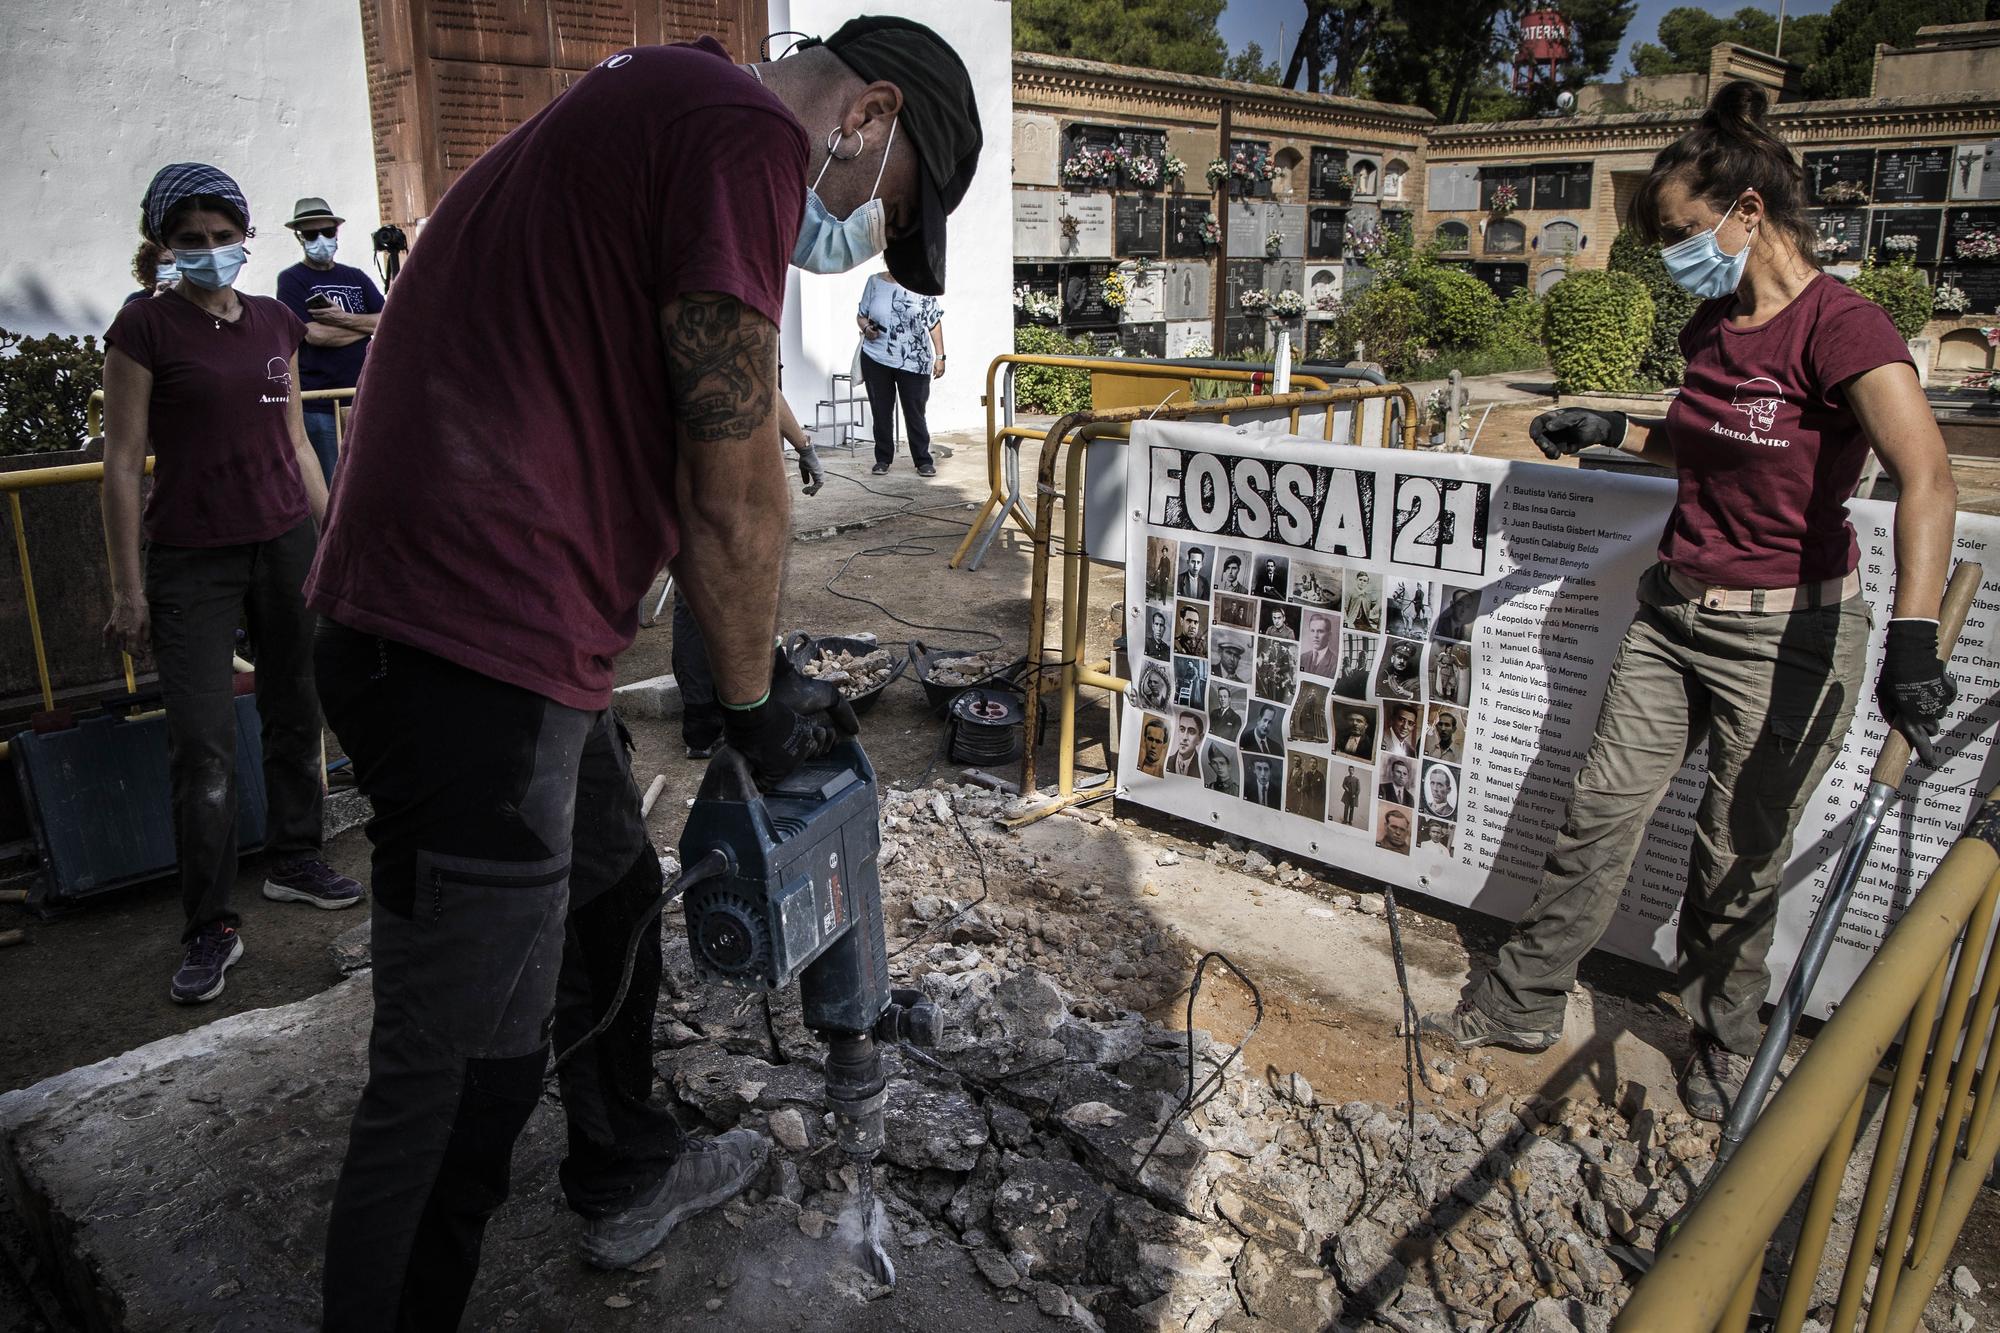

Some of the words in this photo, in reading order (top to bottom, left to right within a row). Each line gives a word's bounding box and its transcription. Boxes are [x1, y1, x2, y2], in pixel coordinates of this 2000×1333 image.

[1505, 485, 1511, 494] 1.
[1514, 486, 1545, 498] Bautista
[1569, 493, 1594, 503] Sirera
[1149, 446, 1373, 559] FOSSA
[1392, 475, 1486, 575] 21
[1513, 503, 1529, 512] Blas
[1532, 506, 1548, 514] Insa
[1511, 519, 1530, 528] Juan
[1532, 521, 1564, 532] Bautista
[1566, 525, 1595, 536] Gisbert
[1542, 539, 1575, 552] Calabuig
[1577, 544, 1599, 554] Belda
[1874, 528, 1888, 538] 53.
[1957, 539, 1987, 550] Soler
[1871, 546, 1885, 556] 54.
[1533, 554, 1558, 564] Bernat
[1560, 558, 1589, 570] Beneyto
[1868, 564, 1882, 574] 55.
[1533, 570, 1562, 581] Beneyto
[1564, 575, 1596, 586] Miralles
[1497, 581, 1503, 589] 7.
[1505, 582, 1530, 593] Ricardo
[1532, 587, 1557, 598] Bernat
[1560, 591, 1598, 602] Sempere
[1865, 583, 1879, 592] 56.
[1503, 598, 1537, 611] Francisco
[1565, 606, 1599, 616] Miralles
[1497, 614, 1532, 625] Leopoldo
[1562, 620, 1598, 632] Monerris
[1482, 626, 1493, 635] 10.
[1495, 629, 1525, 638] Manuel
[1958, 635, 1984, 648] ópez
[1500, 644, 1529, 652] Manuel
[1532, 646, 1561, 658] Galiana
[1563, 652, 1594, 665] Asensio
[1499, 671, 1528, 683] Antonio
[1530, 677, 1551, 688] Vacas
[1525, 662, 1556, 674] Aparicio
[1558, 668, 1588, 680] Moreno
[1481, 682, 1491, 691] 14.
[1480, 697, 1489, 706] 15.
[1495, 701, 1530, 716] Francisco
[1554, 715, 1570, 724] Insa
[1957, 711, 1988, 724] Ribes
[1478, 712, 1487, 721] 16.
[1512, 721, 1532, 731] Soler
[1534, 725, 1561, 739] Tortosa
[1476, 728, 1485, 736] 17.
[1534, 741, 1570, 757] Calatayud
[1474, 742, 1483, 751] 18.
[1521, 753, 1544, 766] Tirado
[1840, 744, 1851, 753] 5.
[1945, 746, 1984, 761] Cuevas
[1472, 757, 1482, 766] 19.
[1514, 768, 1550, 783] Escribano
[1834, 760, 1848, 770] 66.
[1470, 772, 1480, 781] 20.
[1486, 776, 1513, 790] Manuel
[1515, 784, 1548, 799] Segundo
[1831, 778, 1844, 788] 67.
[1904, 775, 1966, 795] Romaguera
[1468, 786, 1478, 795] 21.
[1485, 791, 1510, 803] Ismael
[1512, 798, 1529, 808] Valls
[1531, 802, 1555, 815] Ferrer
[1676, 792, 1698, 804] Valor
[1828, 795, 1841, 806] 68.
[1894, 791, 1921, 804] Soler
[1924, 798, 1961, 813] Gómez
[1467, 801, 1477, 809] 22.
[1484, 805, 1515, 819] Salvador
[1656, 805, 1685, 817] erardo
[1824, 813, 1838, 823] 69.
[1887, 808, 1942, 827] Sanmartín
[1466, 814, 1476, 824] 23.
[1483, 819, 1513, 833] Salvador
[1516, 828, 1533, 839] Valls
[1465, 829, 1475, 838] 24.
[1521, 844, 1544, 857] Chapa
[1648, 834, 1688, 850] Francisco
[1464, 843, 1473, 852] 25.
[1480, 848, 1508, 862] Bautista
[1646, 850, 1677, 863] Antonio
[1462, 857, 1472, 866] 26.
[1478, 861, 1505, 875] Manuel
[1506, 871, 1538, 884] Valverde
[1644, 864, 1673, 878] Vicente
[1817, 863, 1829, 873] 72.
[1881, 862, 1914, 878] Monzó
[1642, 879, 1659, 890] Luis
[1879, 880, 1912, 895] Monzó
[1641, 894, 1672, 909] Roberto
[1873, 895, 1889, 906] Pla
[1638, 910, 1669, 924] Antonio
[1834, 936, 1870, 951] alvador
